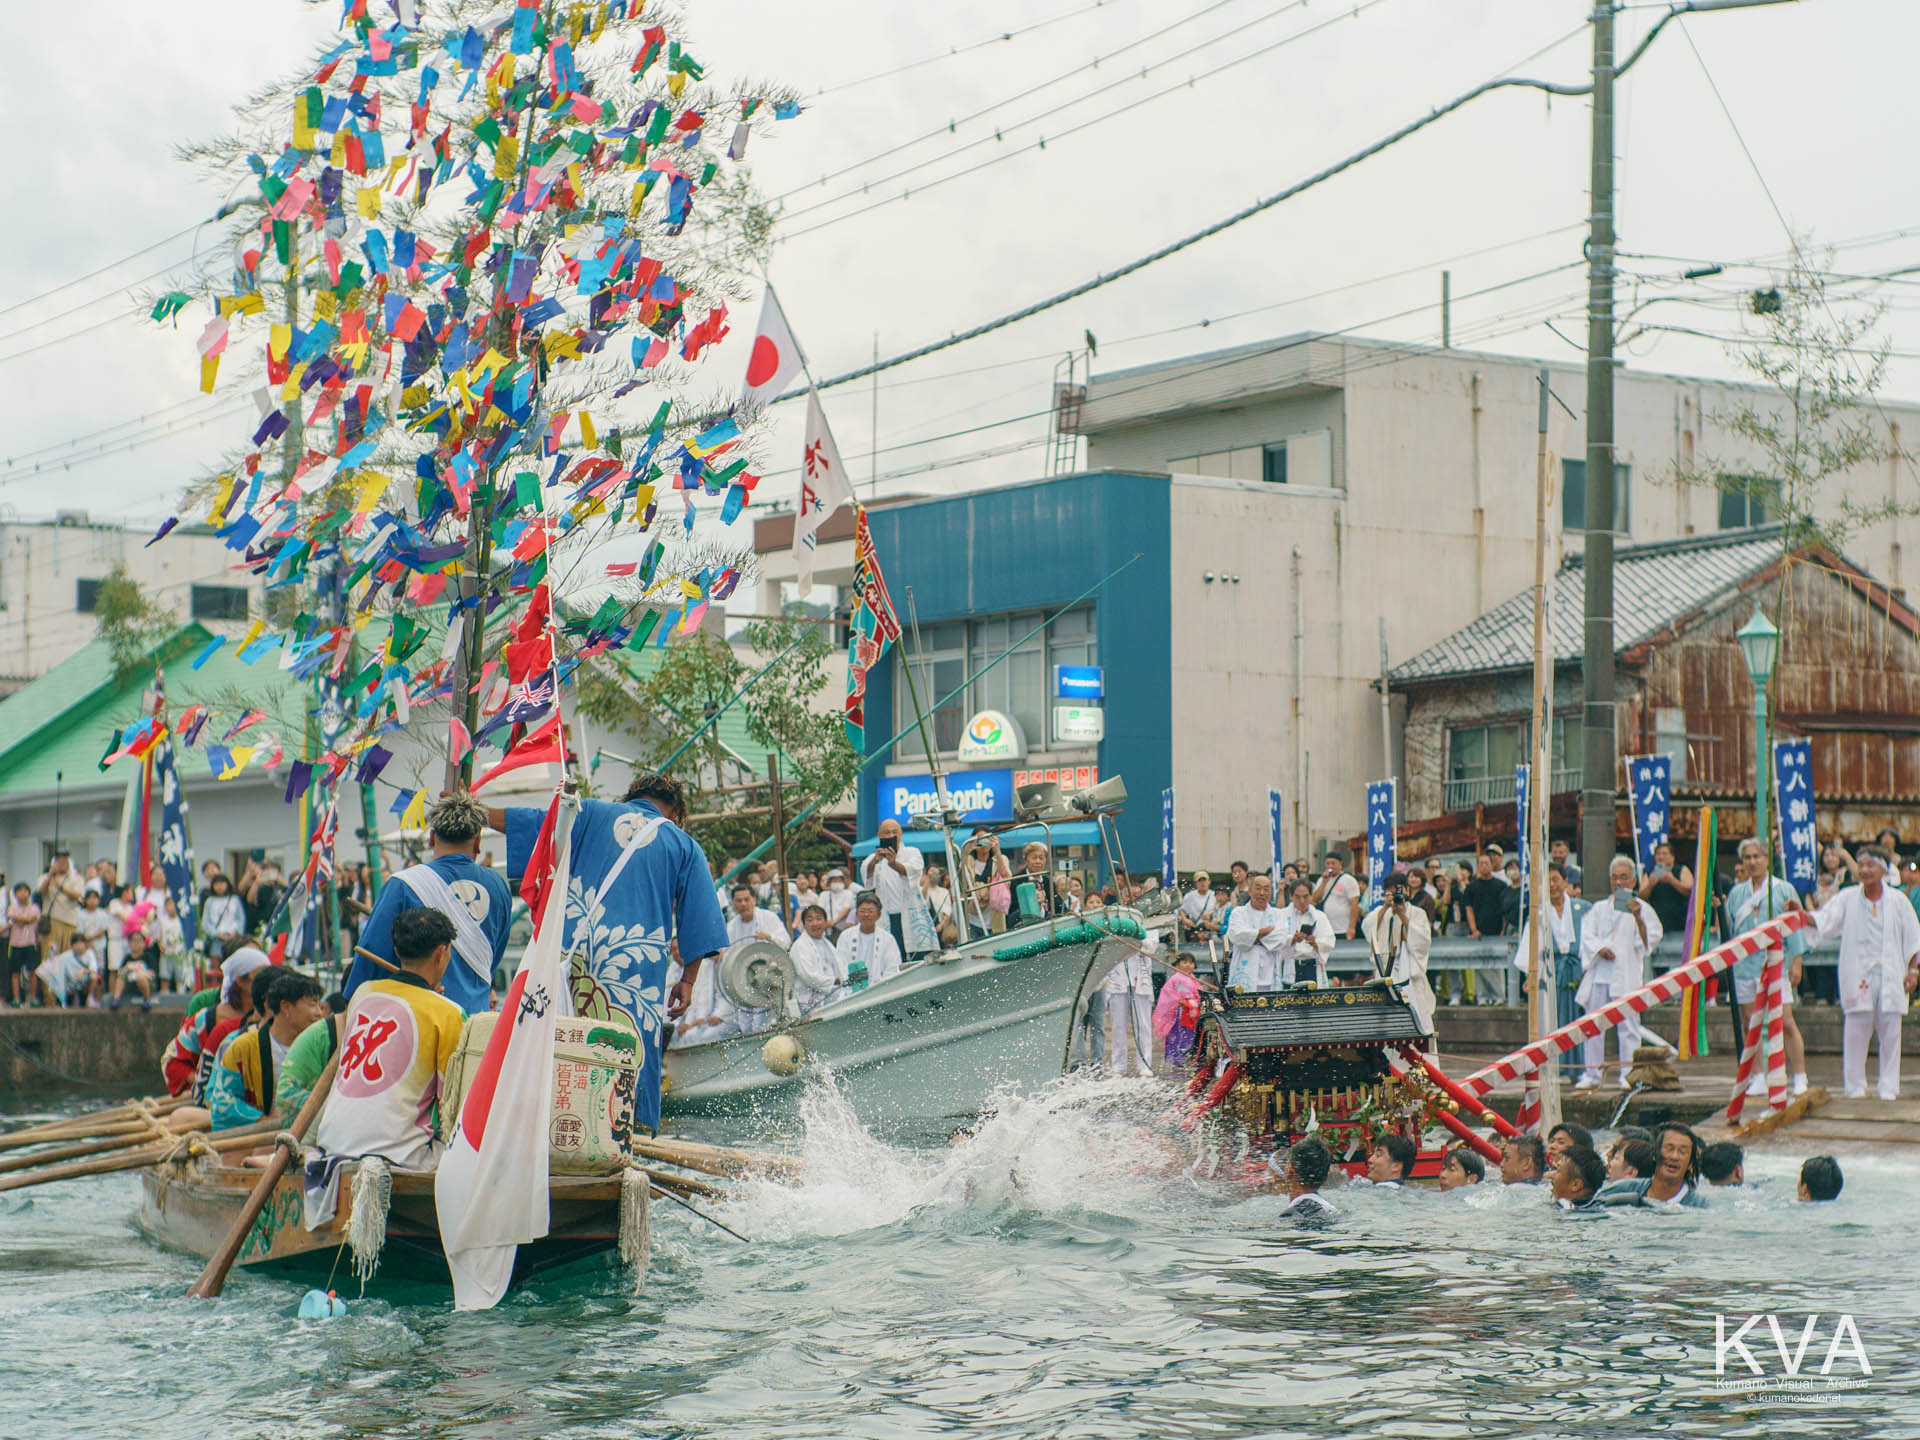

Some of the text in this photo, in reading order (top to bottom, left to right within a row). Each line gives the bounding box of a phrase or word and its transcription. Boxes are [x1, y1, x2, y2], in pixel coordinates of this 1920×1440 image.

[1062, 676, 1100, 688] Panasonic
[894, 781, 994, 815] Panasonic
[339, 1012, 398, 1082] 祝
